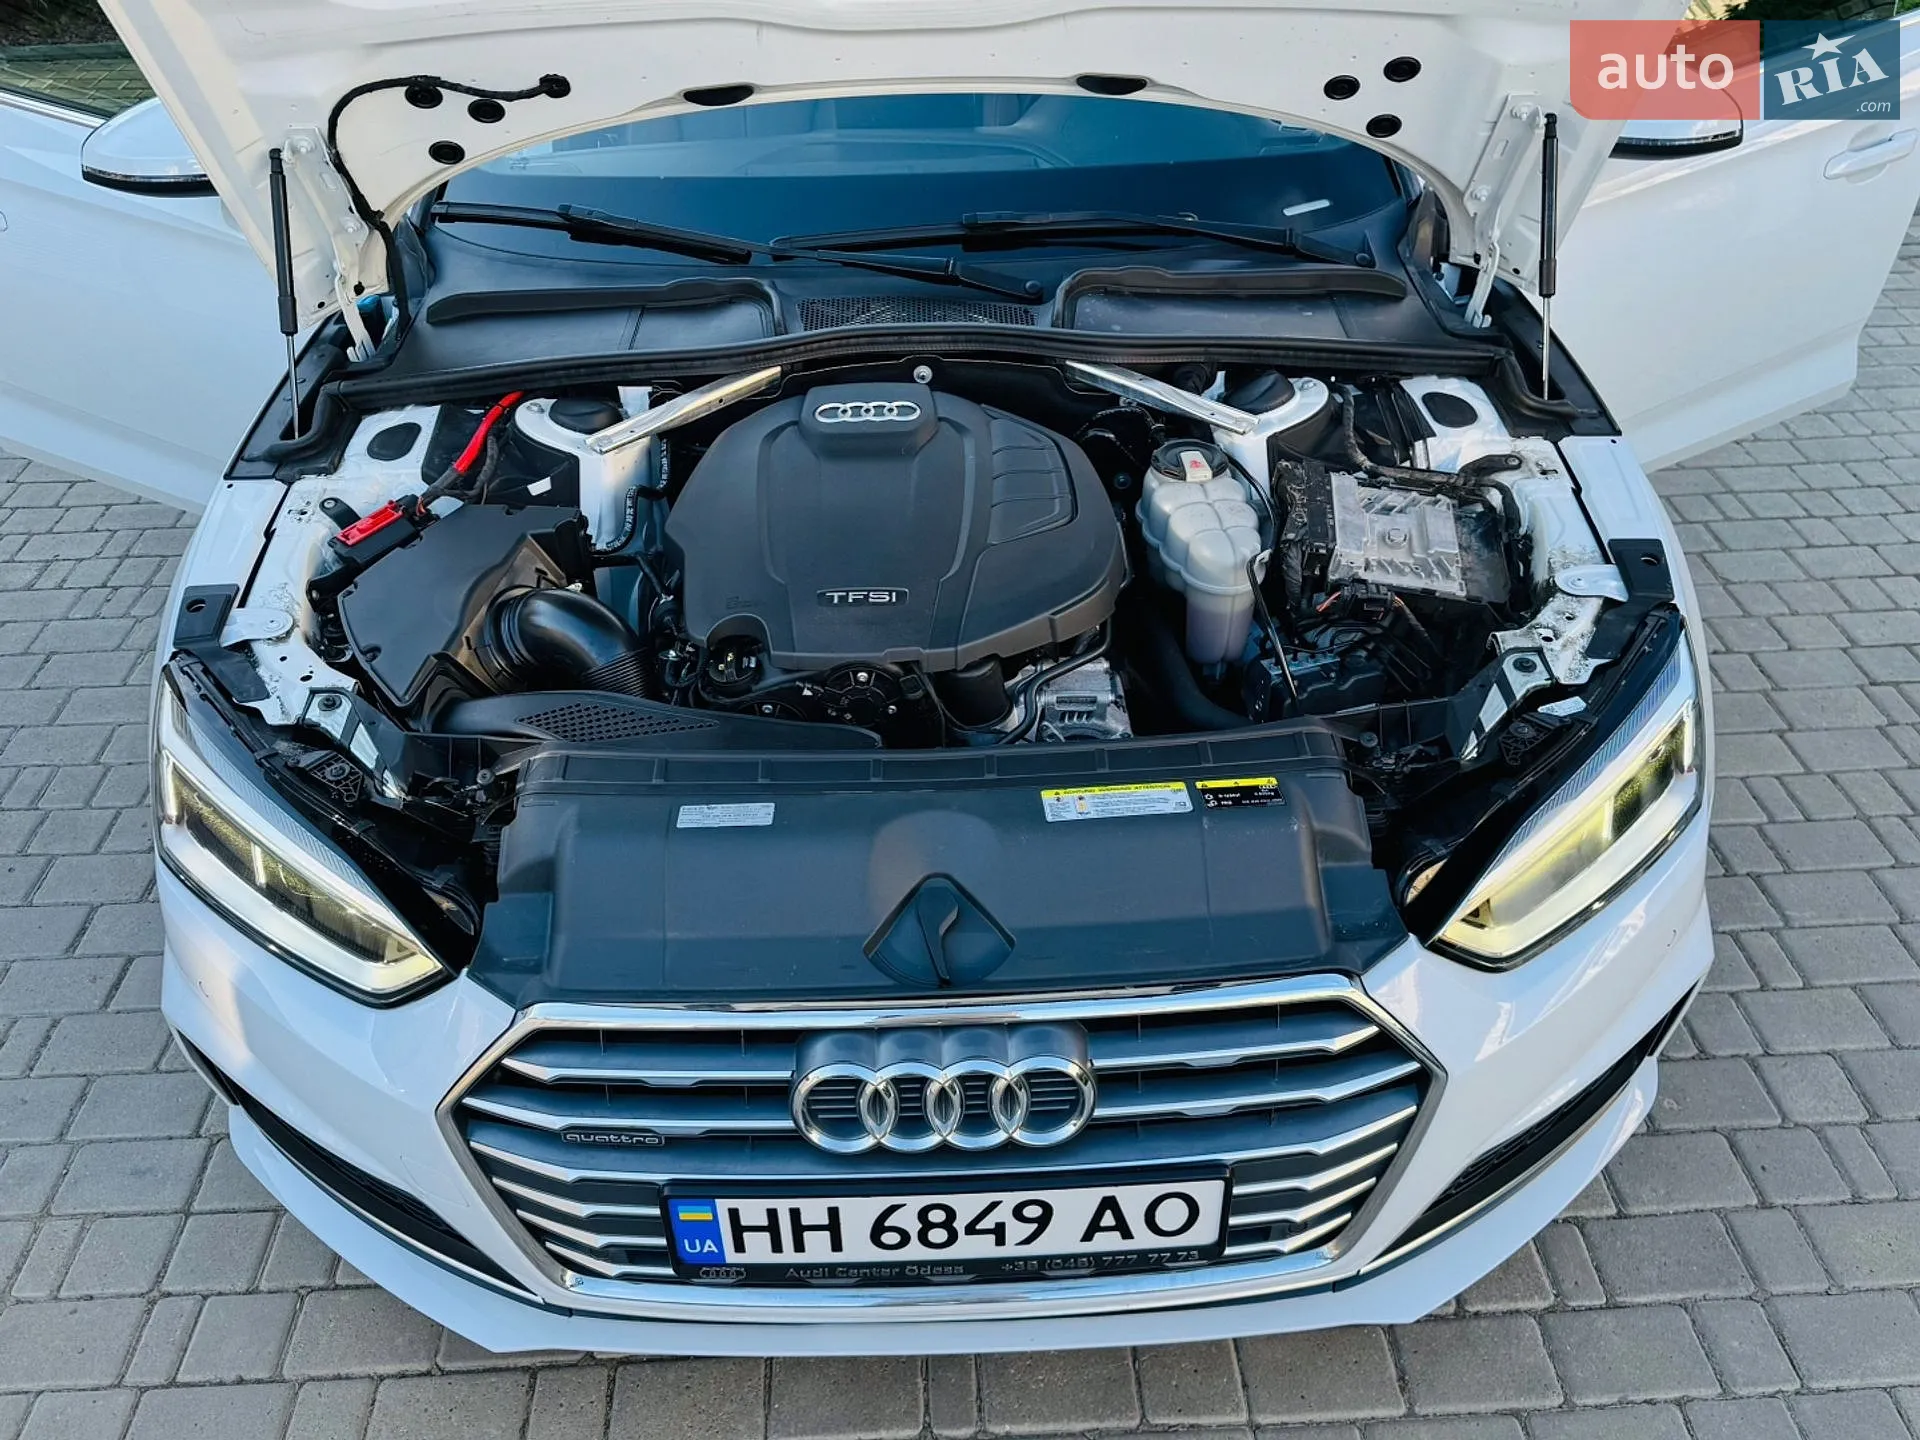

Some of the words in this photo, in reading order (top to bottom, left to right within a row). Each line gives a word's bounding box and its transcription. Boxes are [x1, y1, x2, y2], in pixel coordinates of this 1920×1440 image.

[825, 591, 897, 604] TFSI
[566, 1133, 659, 1145] quattro
[728, 1206, 844, 1255] HH
[869, 1198, 1055, 1251] 6849
[1079, 1191, 1201, 1242] AO
[684, 1239, 719, 1255] UA
[1102, 1254, 1138, 1267] 777
[1148, 1252, 1171, 1264] 77
[1177, 1250, 1200, 1261] 73
[785, 1267, 829, 1279] Audi
